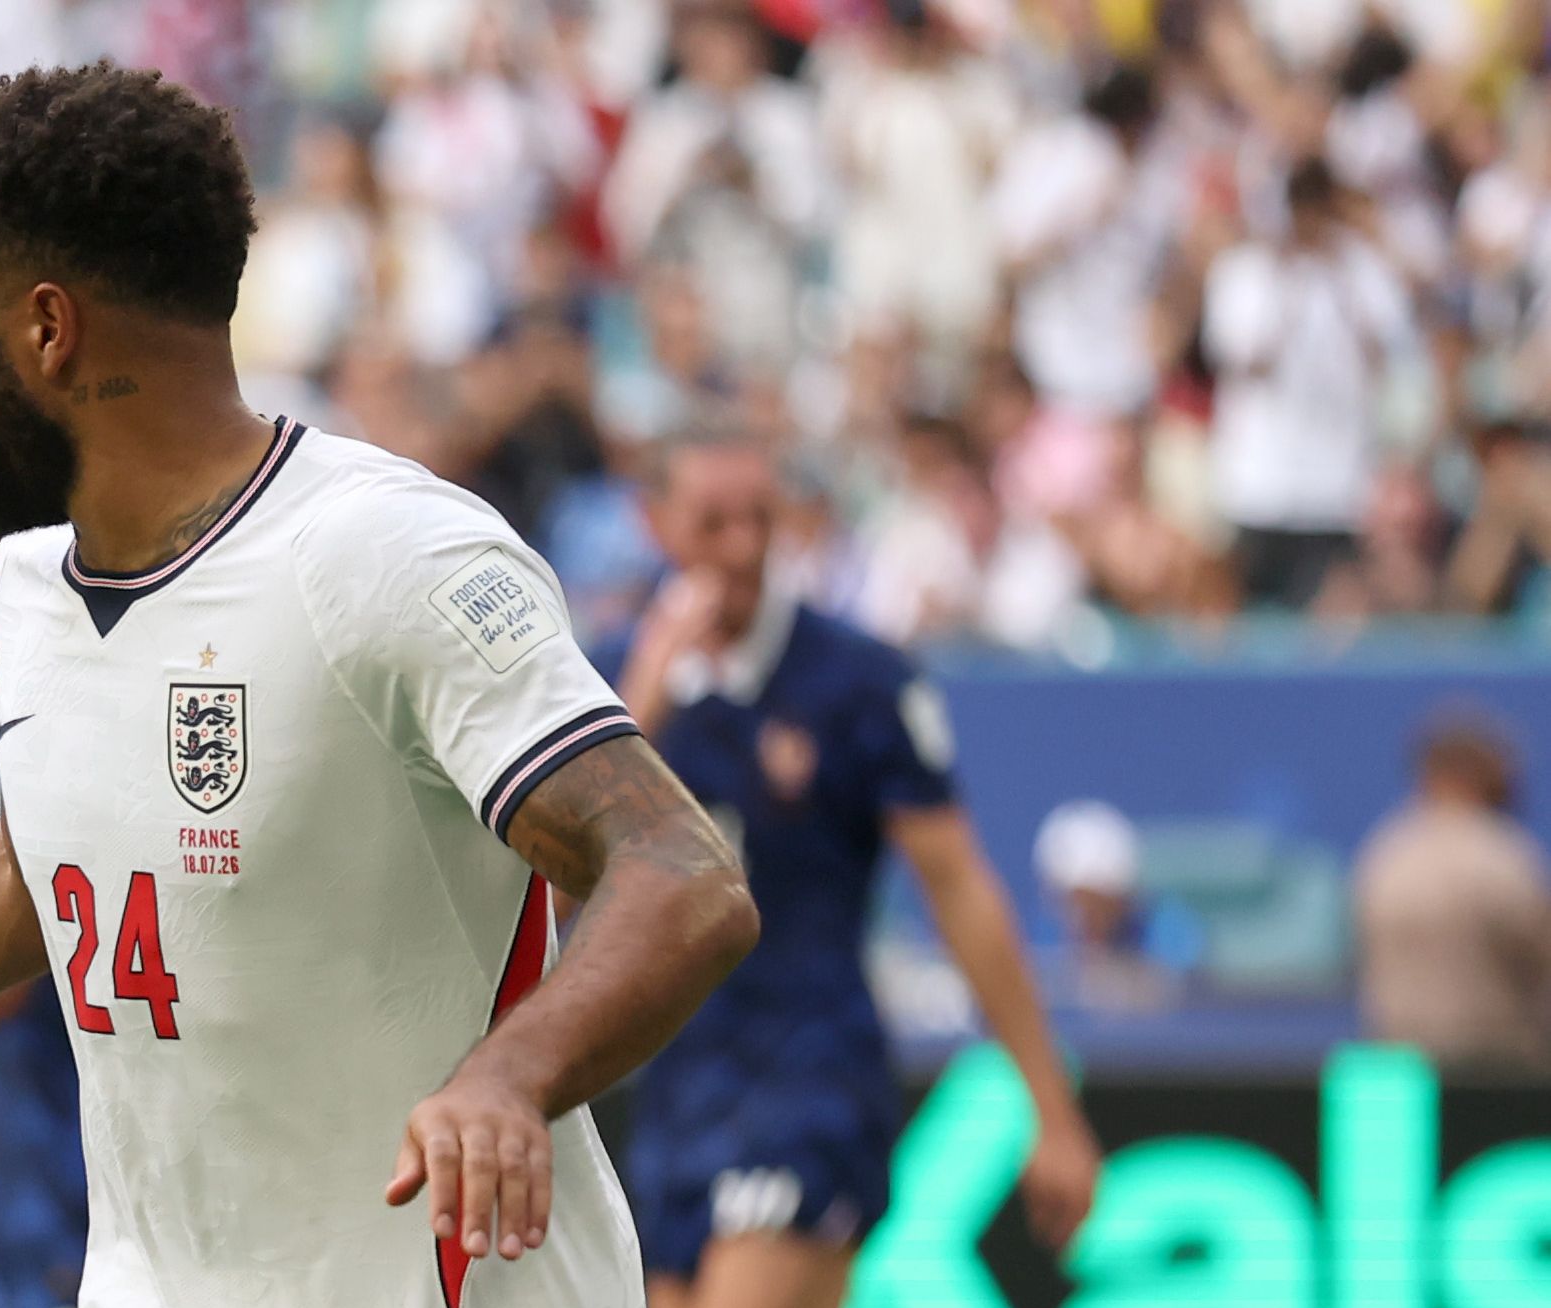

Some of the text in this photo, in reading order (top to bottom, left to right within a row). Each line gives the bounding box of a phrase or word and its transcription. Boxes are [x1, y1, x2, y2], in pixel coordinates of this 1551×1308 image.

[449, 564, 508, 608] FOOTBALL
[462, 576, 523, 625] UNITES
[479, 594, 540, 645] the World
[510, 622, 535, 642] FIFA
[179, 827, 241, 849] FRANCE
[183, 854, 240, 874] 18.07.26
[52, 863, 181, 1040] 24
